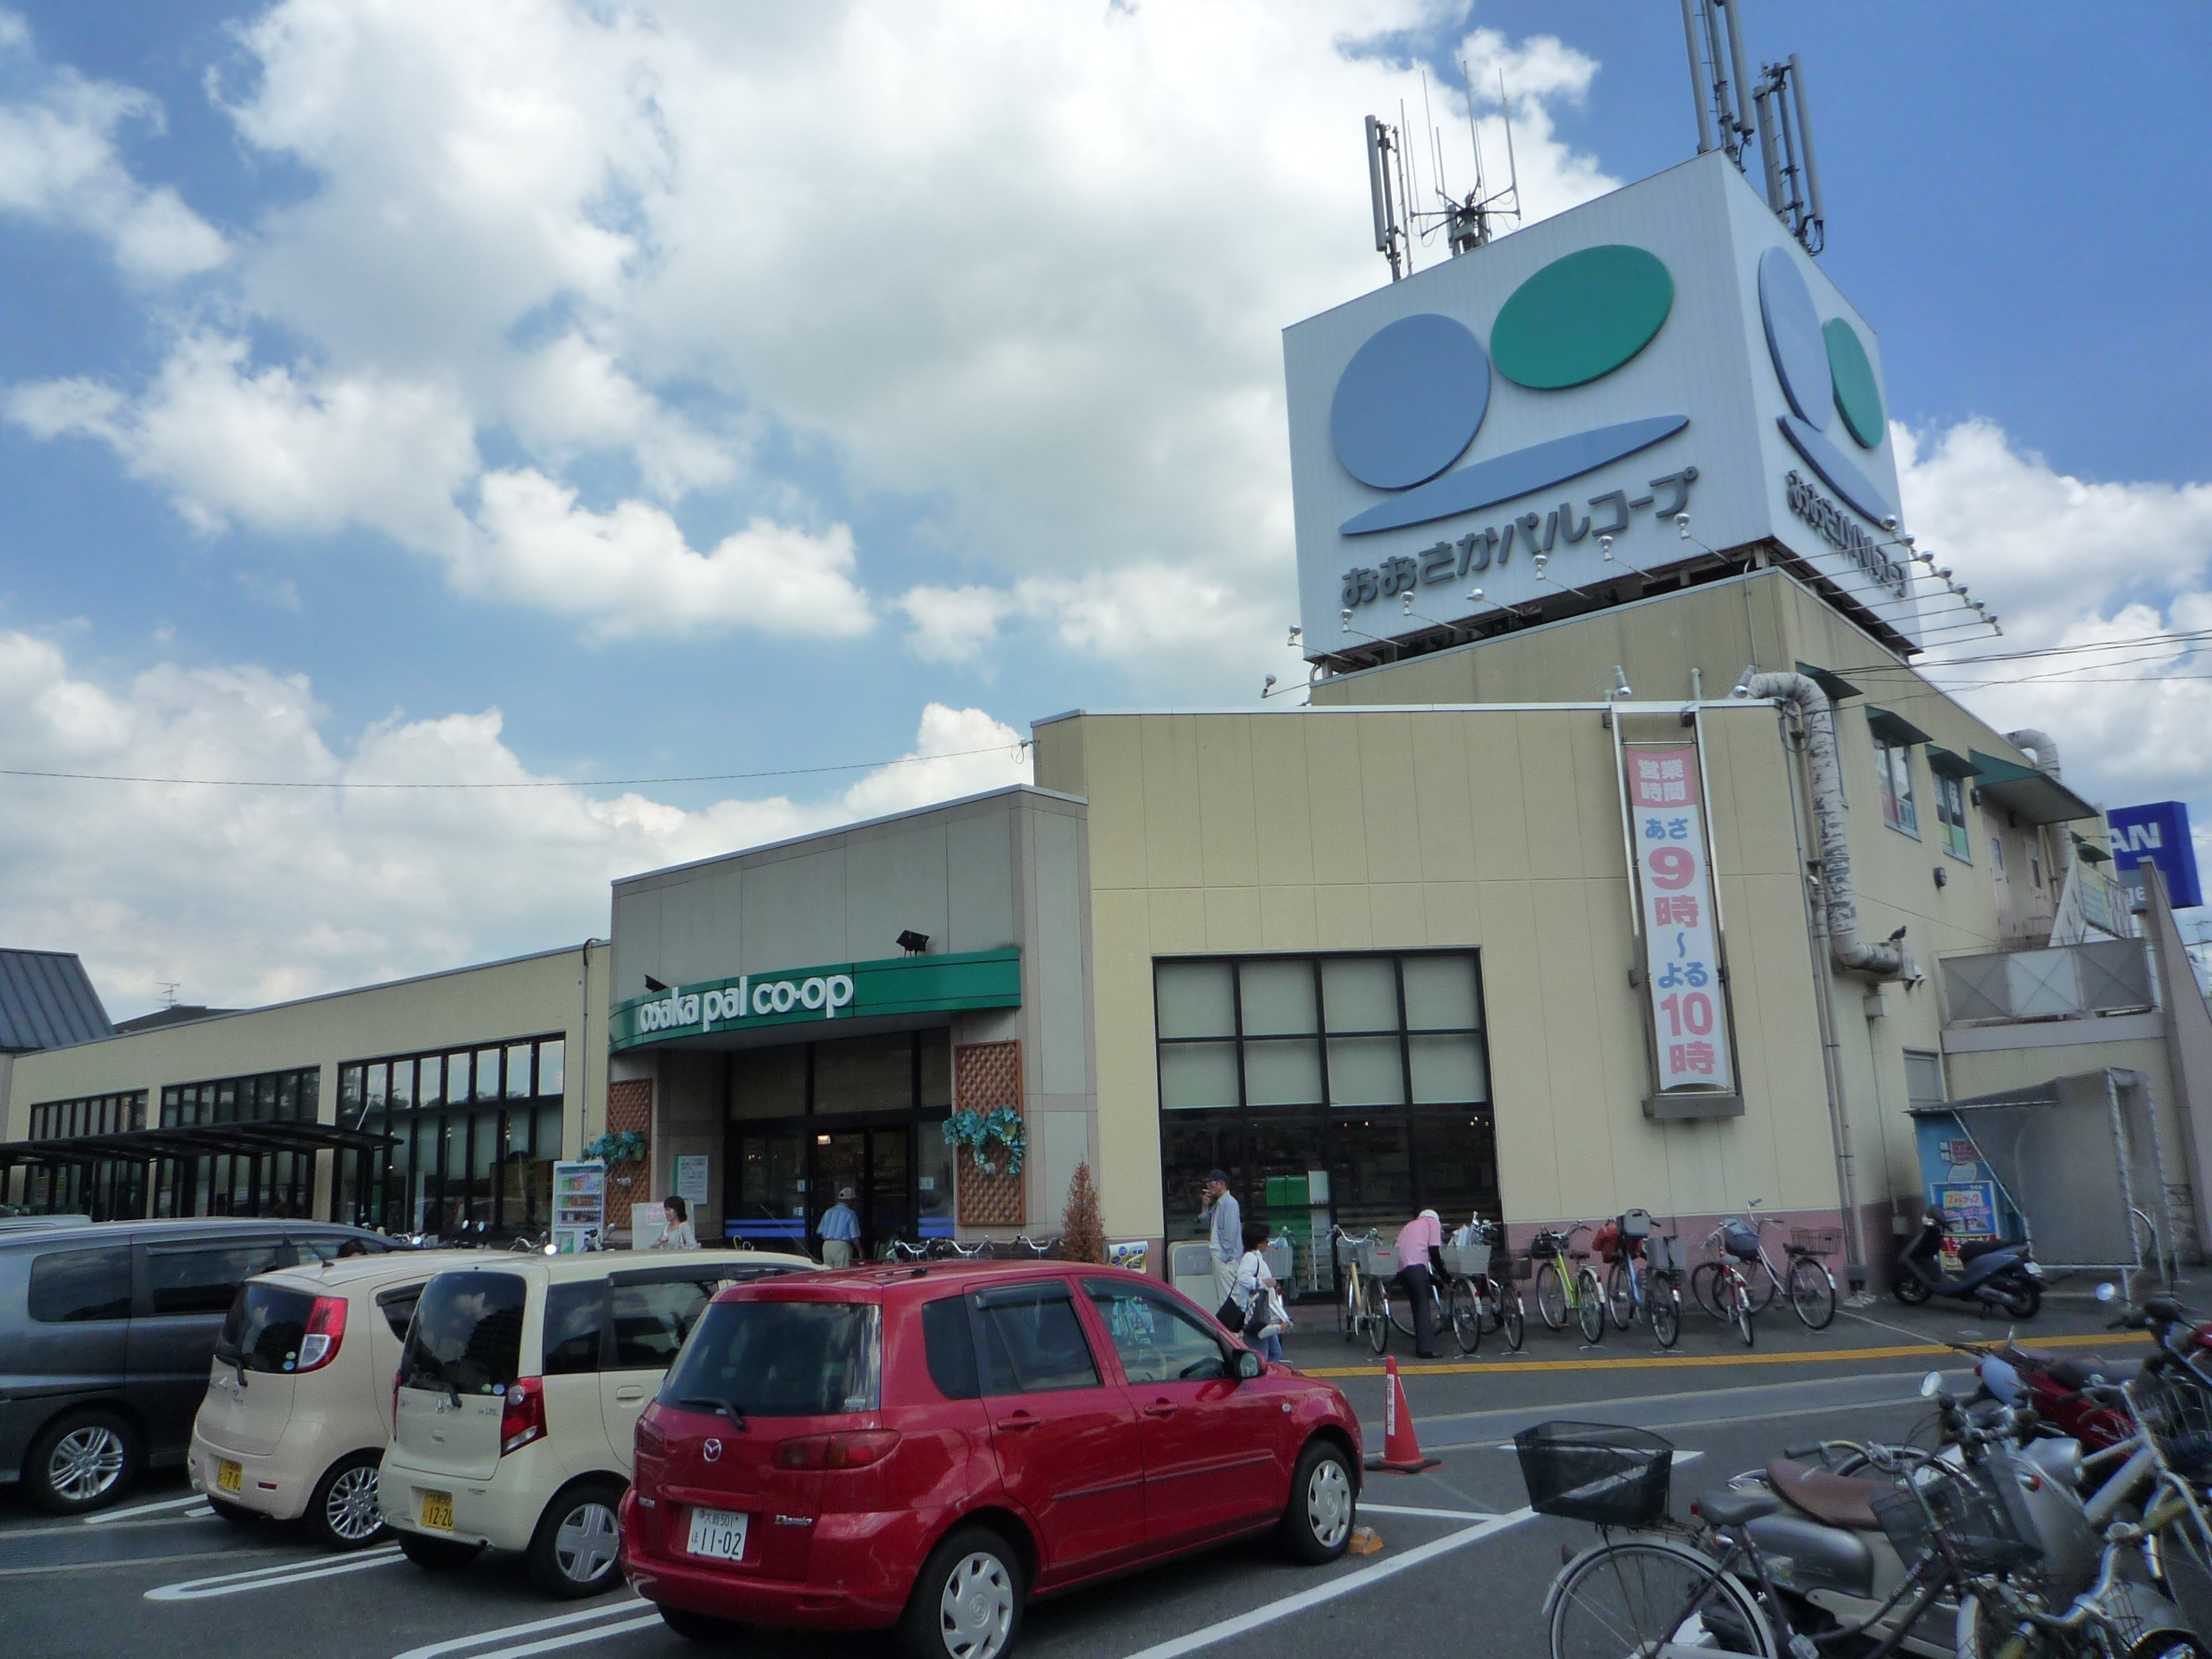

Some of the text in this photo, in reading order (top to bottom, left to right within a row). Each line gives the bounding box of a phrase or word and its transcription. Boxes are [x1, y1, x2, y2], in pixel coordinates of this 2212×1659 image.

[1341, 466, 1699, 607] おおさかパルコープ
[1637, 759, 1684, 779] 営業
[1641, 781, 1687, 803] 時間
[1644, 817, 1689, 840] あさ
[1657, 962, 1709, 989] よる
[639, 987, 699, 1033] osaka
[702, 976, 748, 1032] pal
